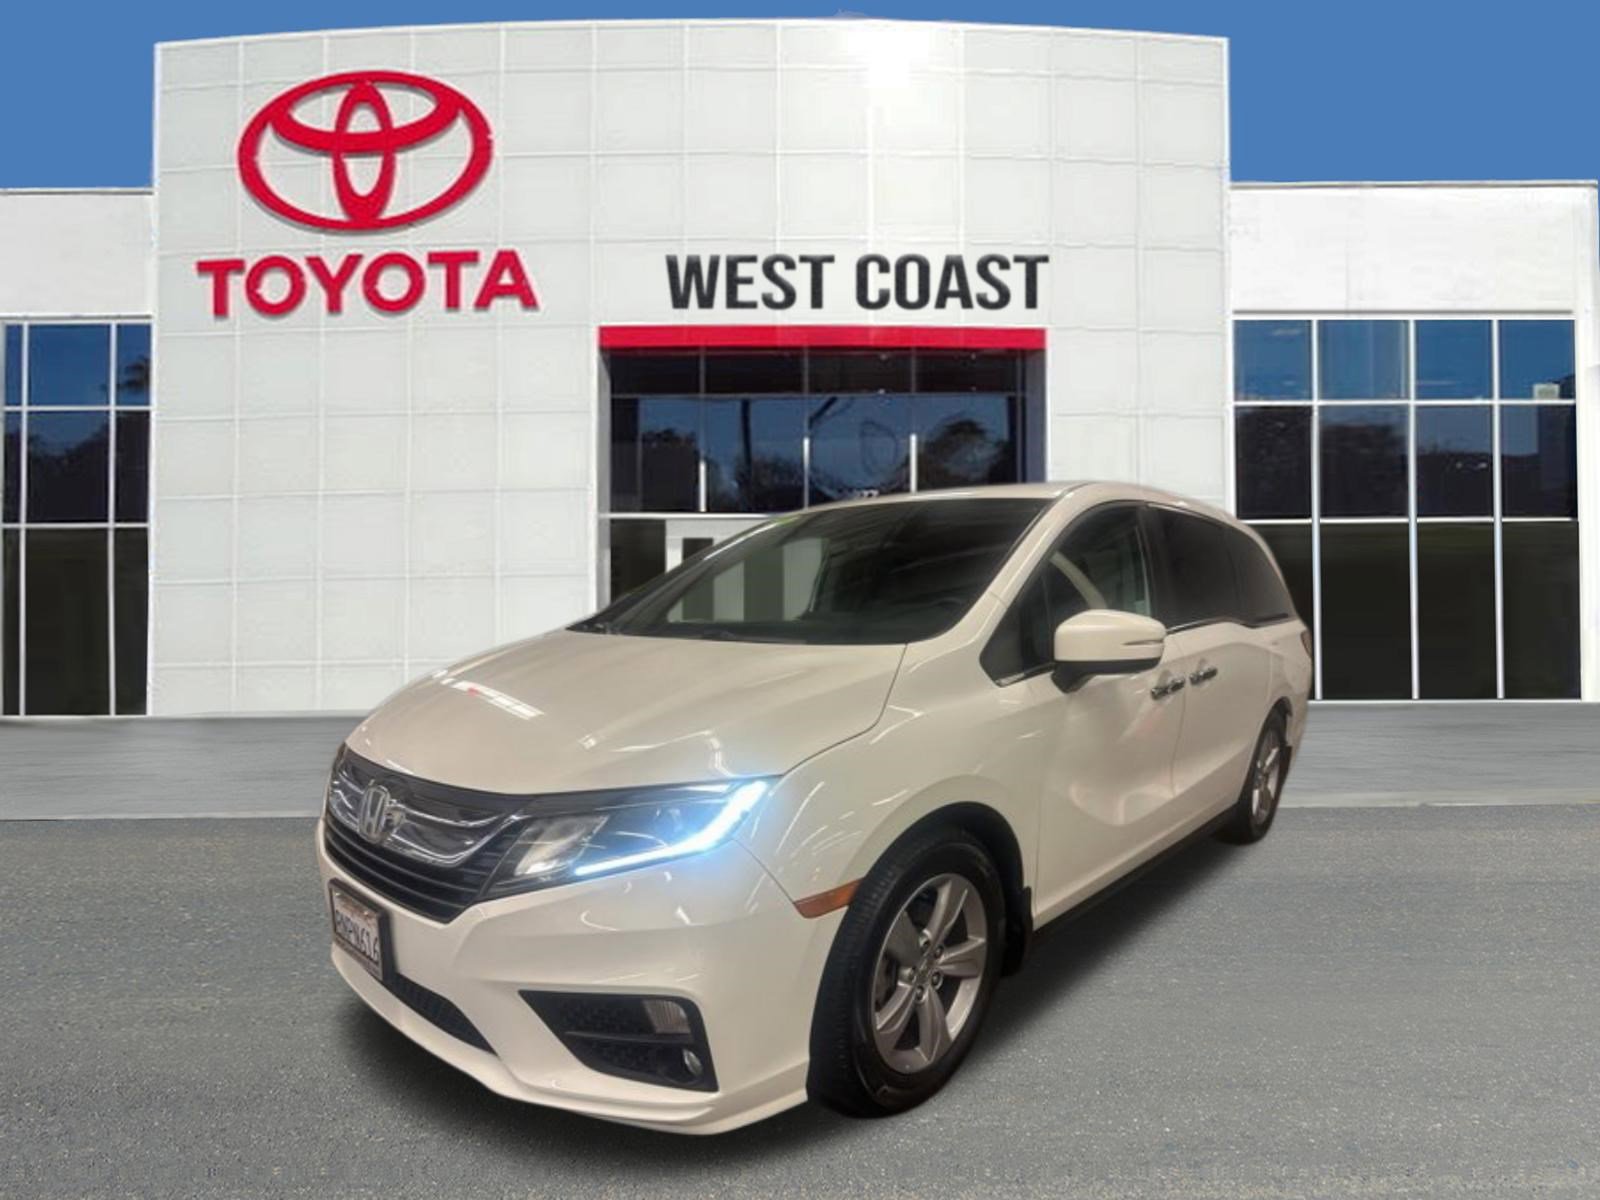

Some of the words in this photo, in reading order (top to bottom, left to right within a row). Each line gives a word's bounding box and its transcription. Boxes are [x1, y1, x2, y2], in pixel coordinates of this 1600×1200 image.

[195, 249, 538, 318] TOYOTA
[667, 254, 835, 310] WEST
[857, 254, 1049, 310] COAST
